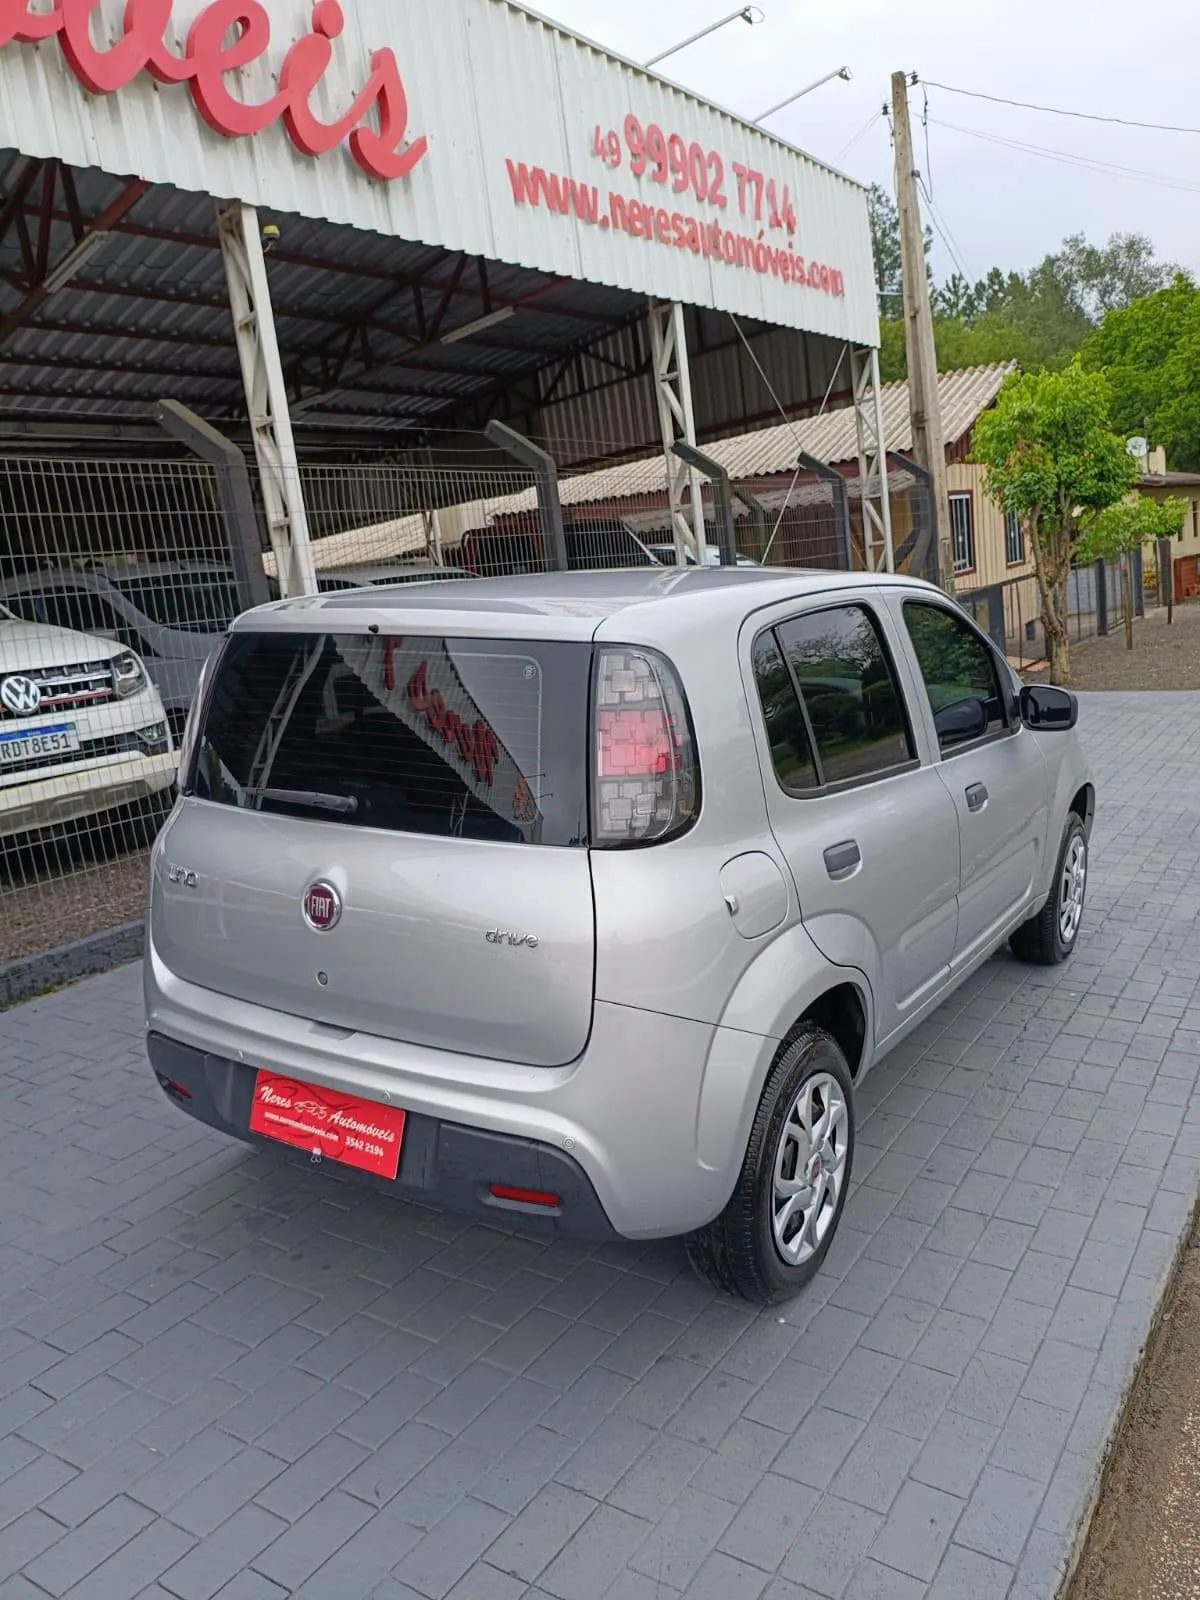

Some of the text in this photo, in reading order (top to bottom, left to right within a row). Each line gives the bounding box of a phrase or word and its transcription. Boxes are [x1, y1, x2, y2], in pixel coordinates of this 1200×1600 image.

[594, 113, 797, 235] 49 99902 7714
[505, 158, 845, 298] www.neresautomóveis.com
[0, 733, 71, 760] RDT8E51
[311, 895, 332, 919] FIAT
[485, 927, 539, 948] drive
[260, 1085, 396, 1142] Neres Automóveis
